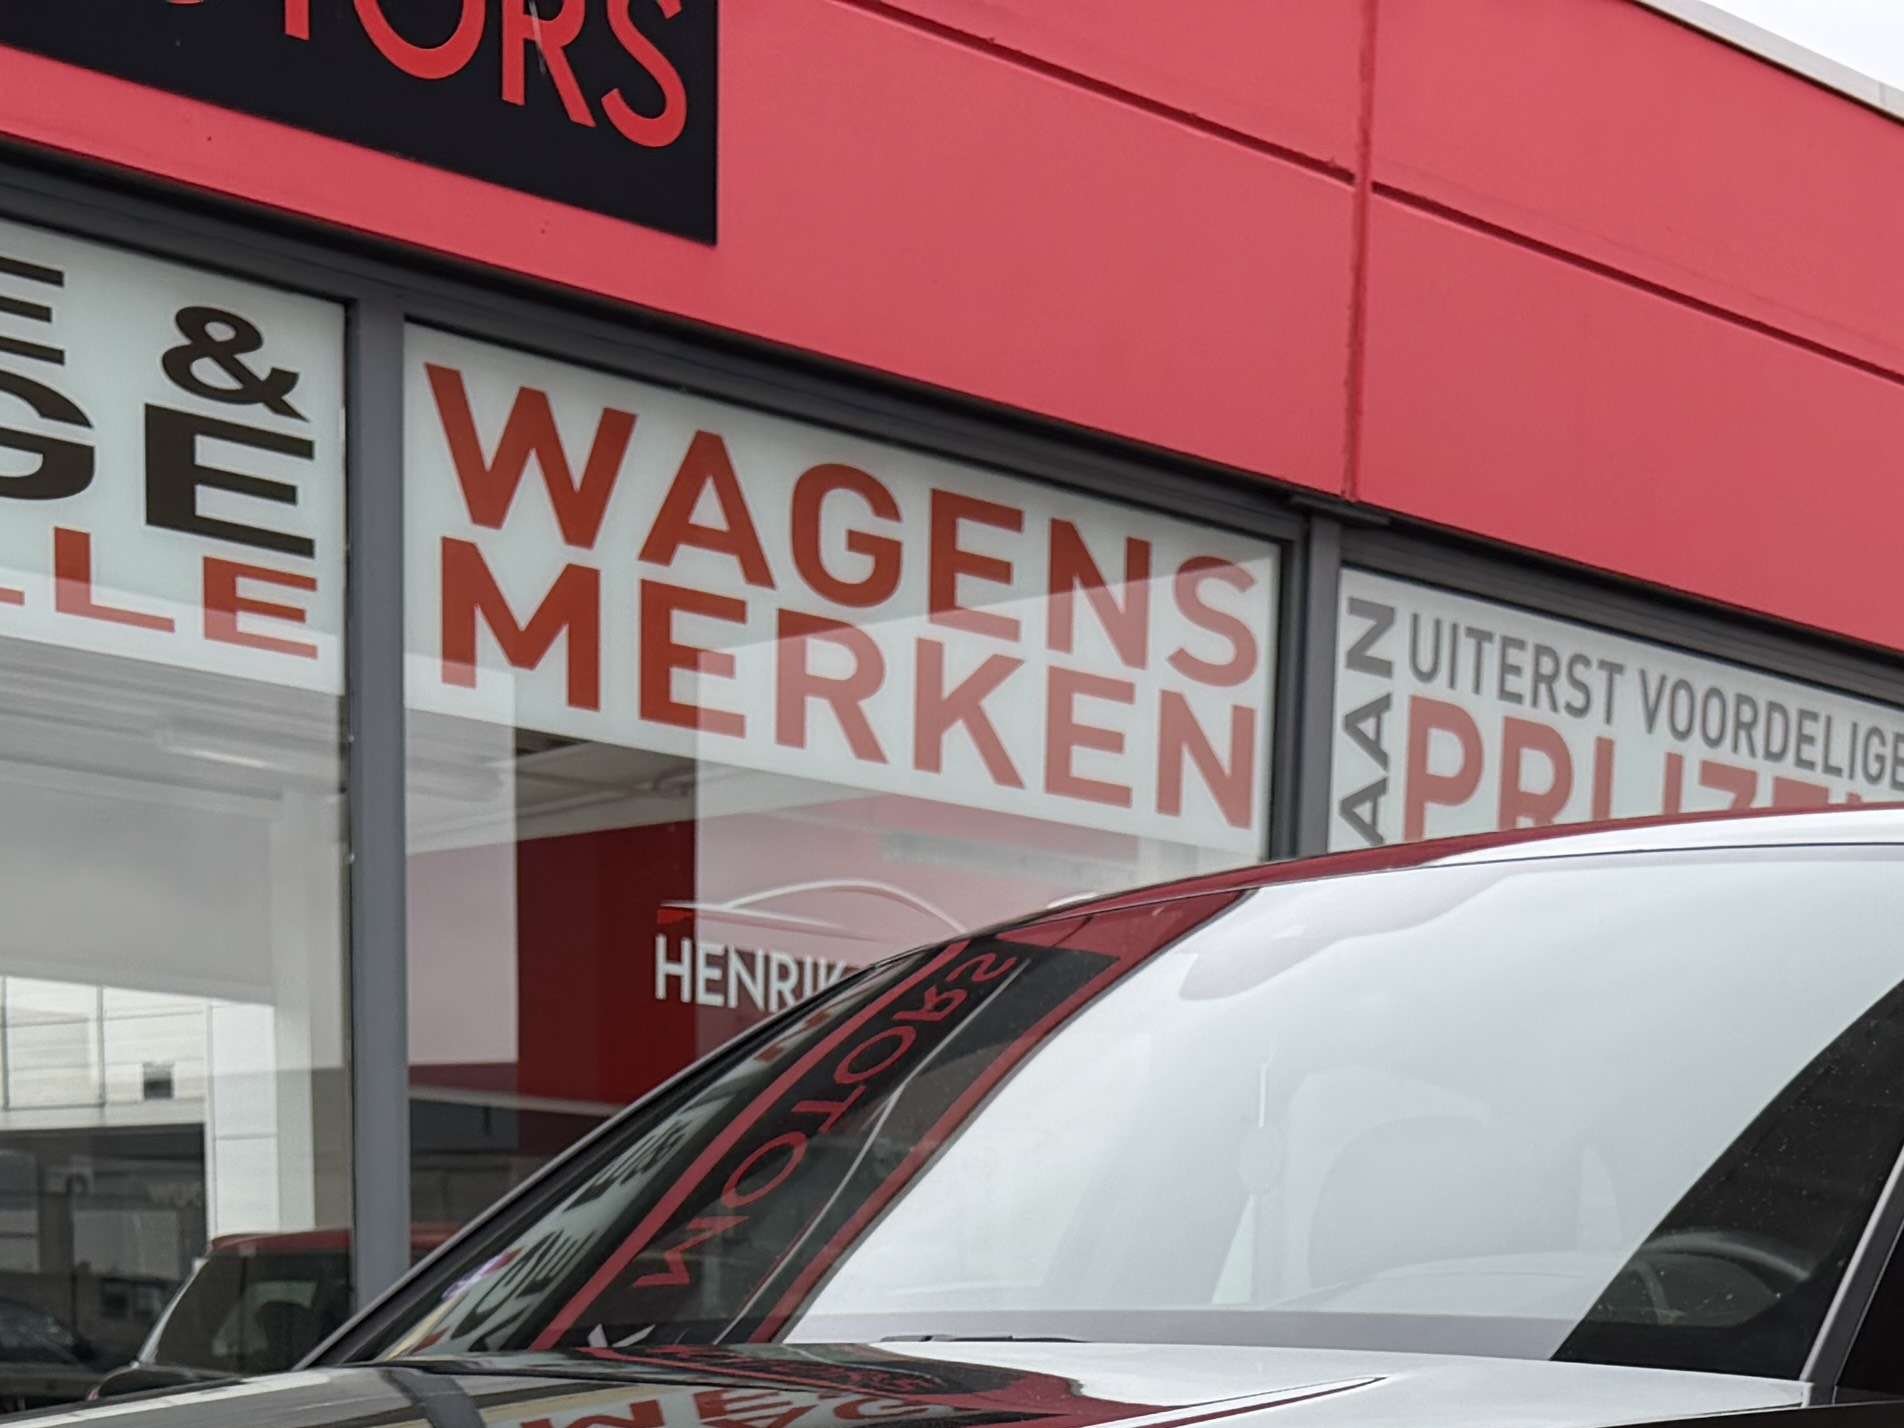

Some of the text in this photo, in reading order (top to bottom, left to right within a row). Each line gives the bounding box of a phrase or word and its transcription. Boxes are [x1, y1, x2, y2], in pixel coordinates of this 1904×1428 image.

[160, 305, 310, 423] &
[424, 362, 1259, 687] WAGENS
[441, 535, 1256, 830] MERKEN
[1338, 596, 1396, 846] AAN
[1408, 611, 1624, 725] UITERST
